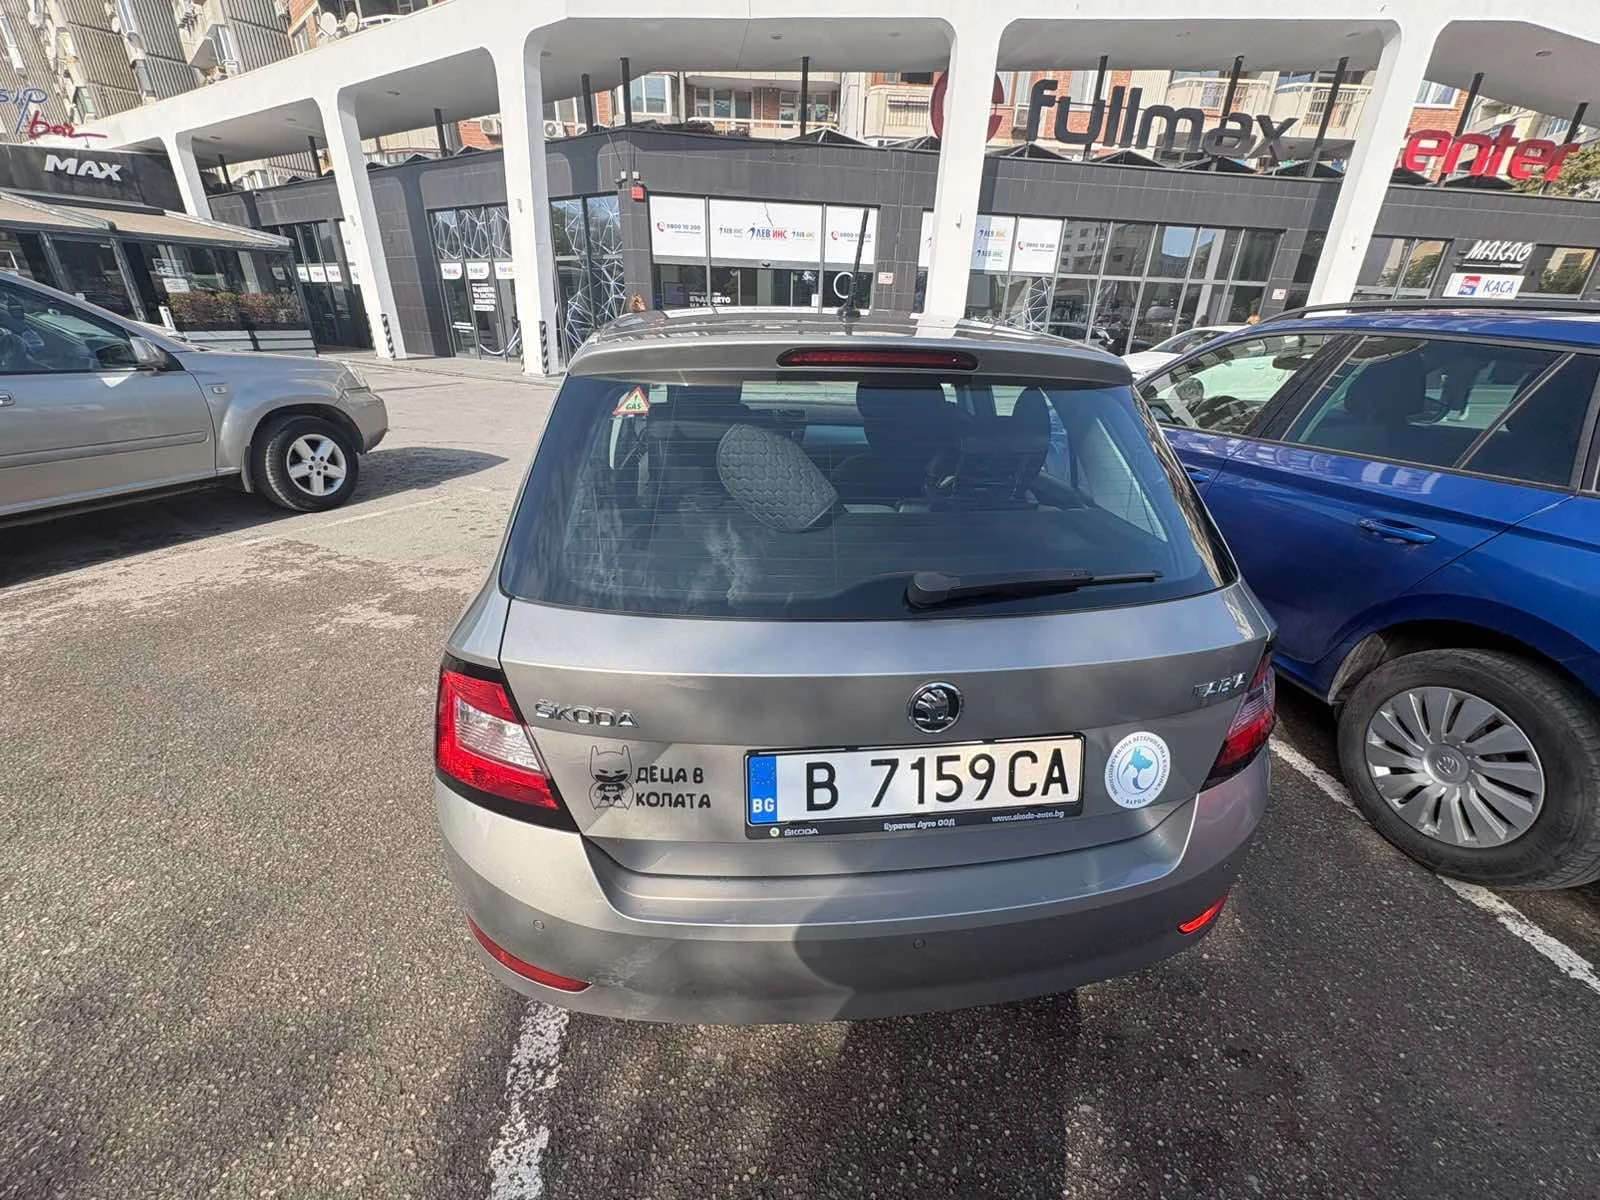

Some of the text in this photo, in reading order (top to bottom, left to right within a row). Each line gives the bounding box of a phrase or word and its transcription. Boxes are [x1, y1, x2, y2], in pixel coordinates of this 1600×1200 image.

[1027, 79, 1582, 183] fullmax enter
[44, 154, 122, 182] MAX
[756, 228, 788, 239] ЛЕВ ИНС
[625, 402, 642, 410] GAS
[534, 699, 640, 729] ŠKODA
[635, 765, 704, 785] ДЕЦА В
[870, 753, 996, 809] 7159
[635, 791, 712, 809] КОЛАТА
[752, 798, 775, 814] BG
